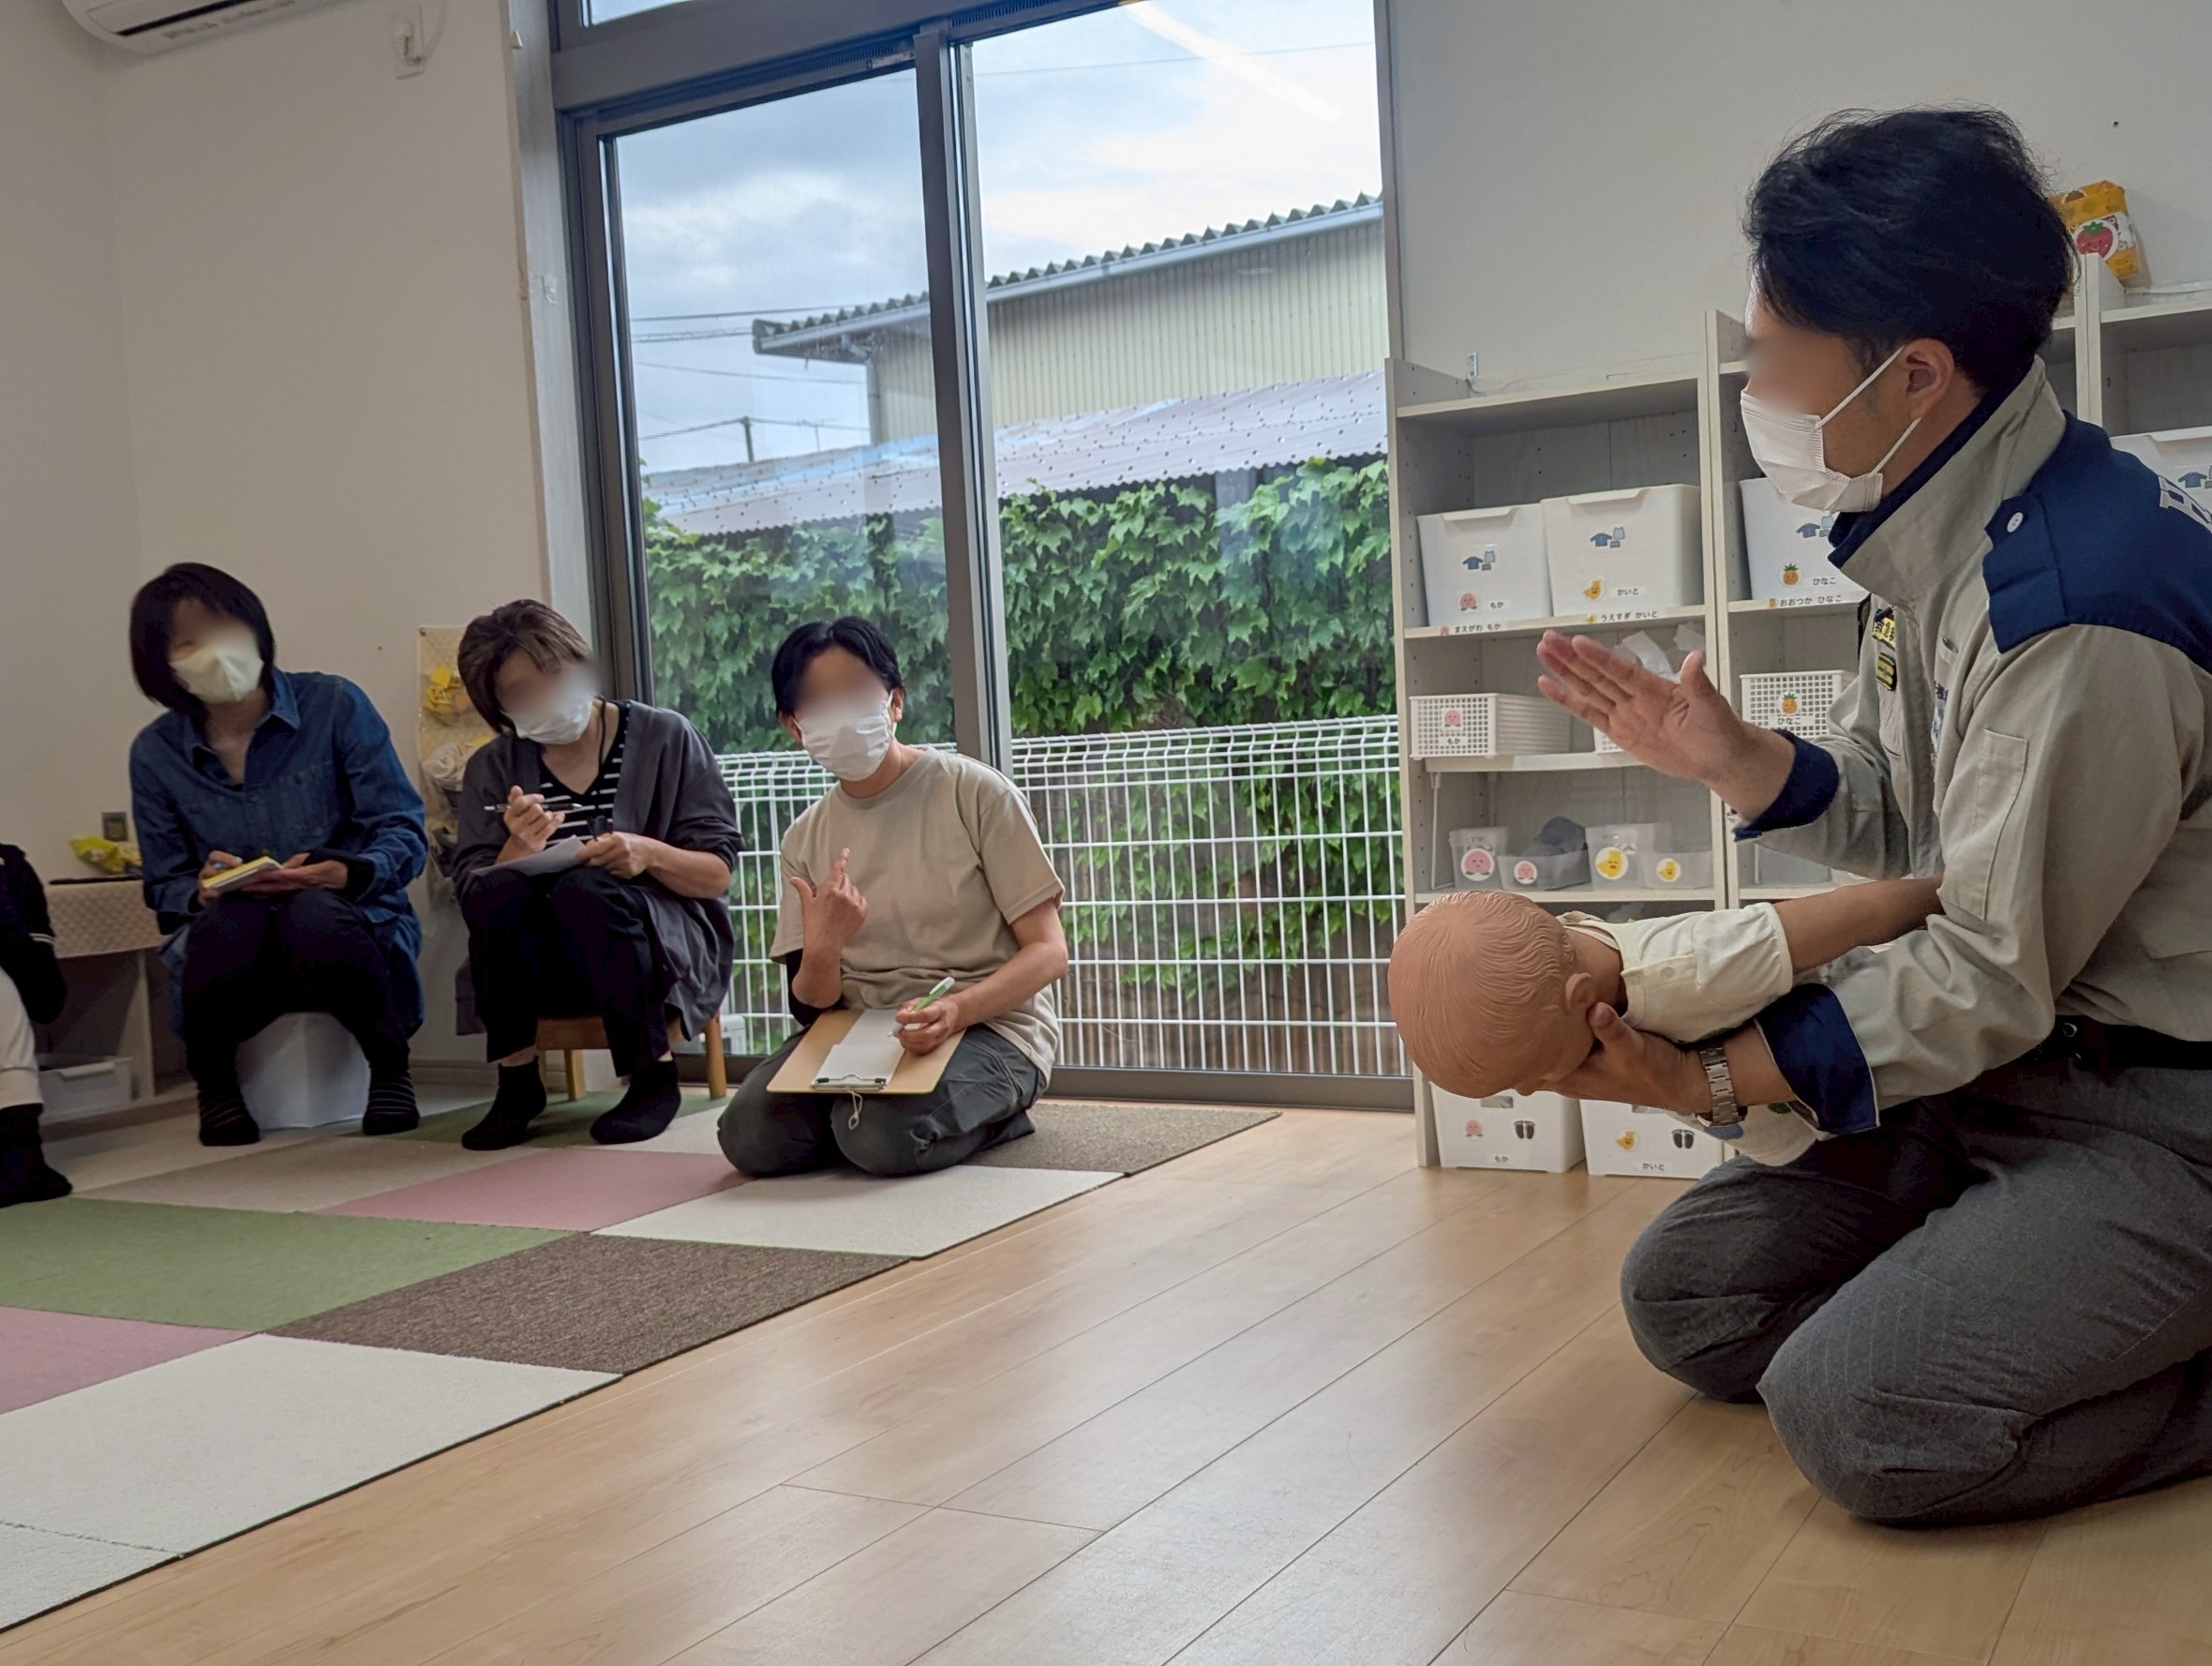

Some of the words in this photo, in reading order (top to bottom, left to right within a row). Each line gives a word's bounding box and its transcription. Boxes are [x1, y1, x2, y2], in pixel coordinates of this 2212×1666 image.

[1813, 578, 1836, 586] ひなこ
[1617, 587, 1639, 596] かいと
[1780, 597, 1813, 607] おおつか
[1817, 594, 1842, 604] ひなこ
[1601, 611, 1632, 622] うえすぎ
[1635, 610, 1658, 620] かいと
[1777, 717, 1801, 726] ひなこ
[1642, 1162, 1665, 1171] かいと
